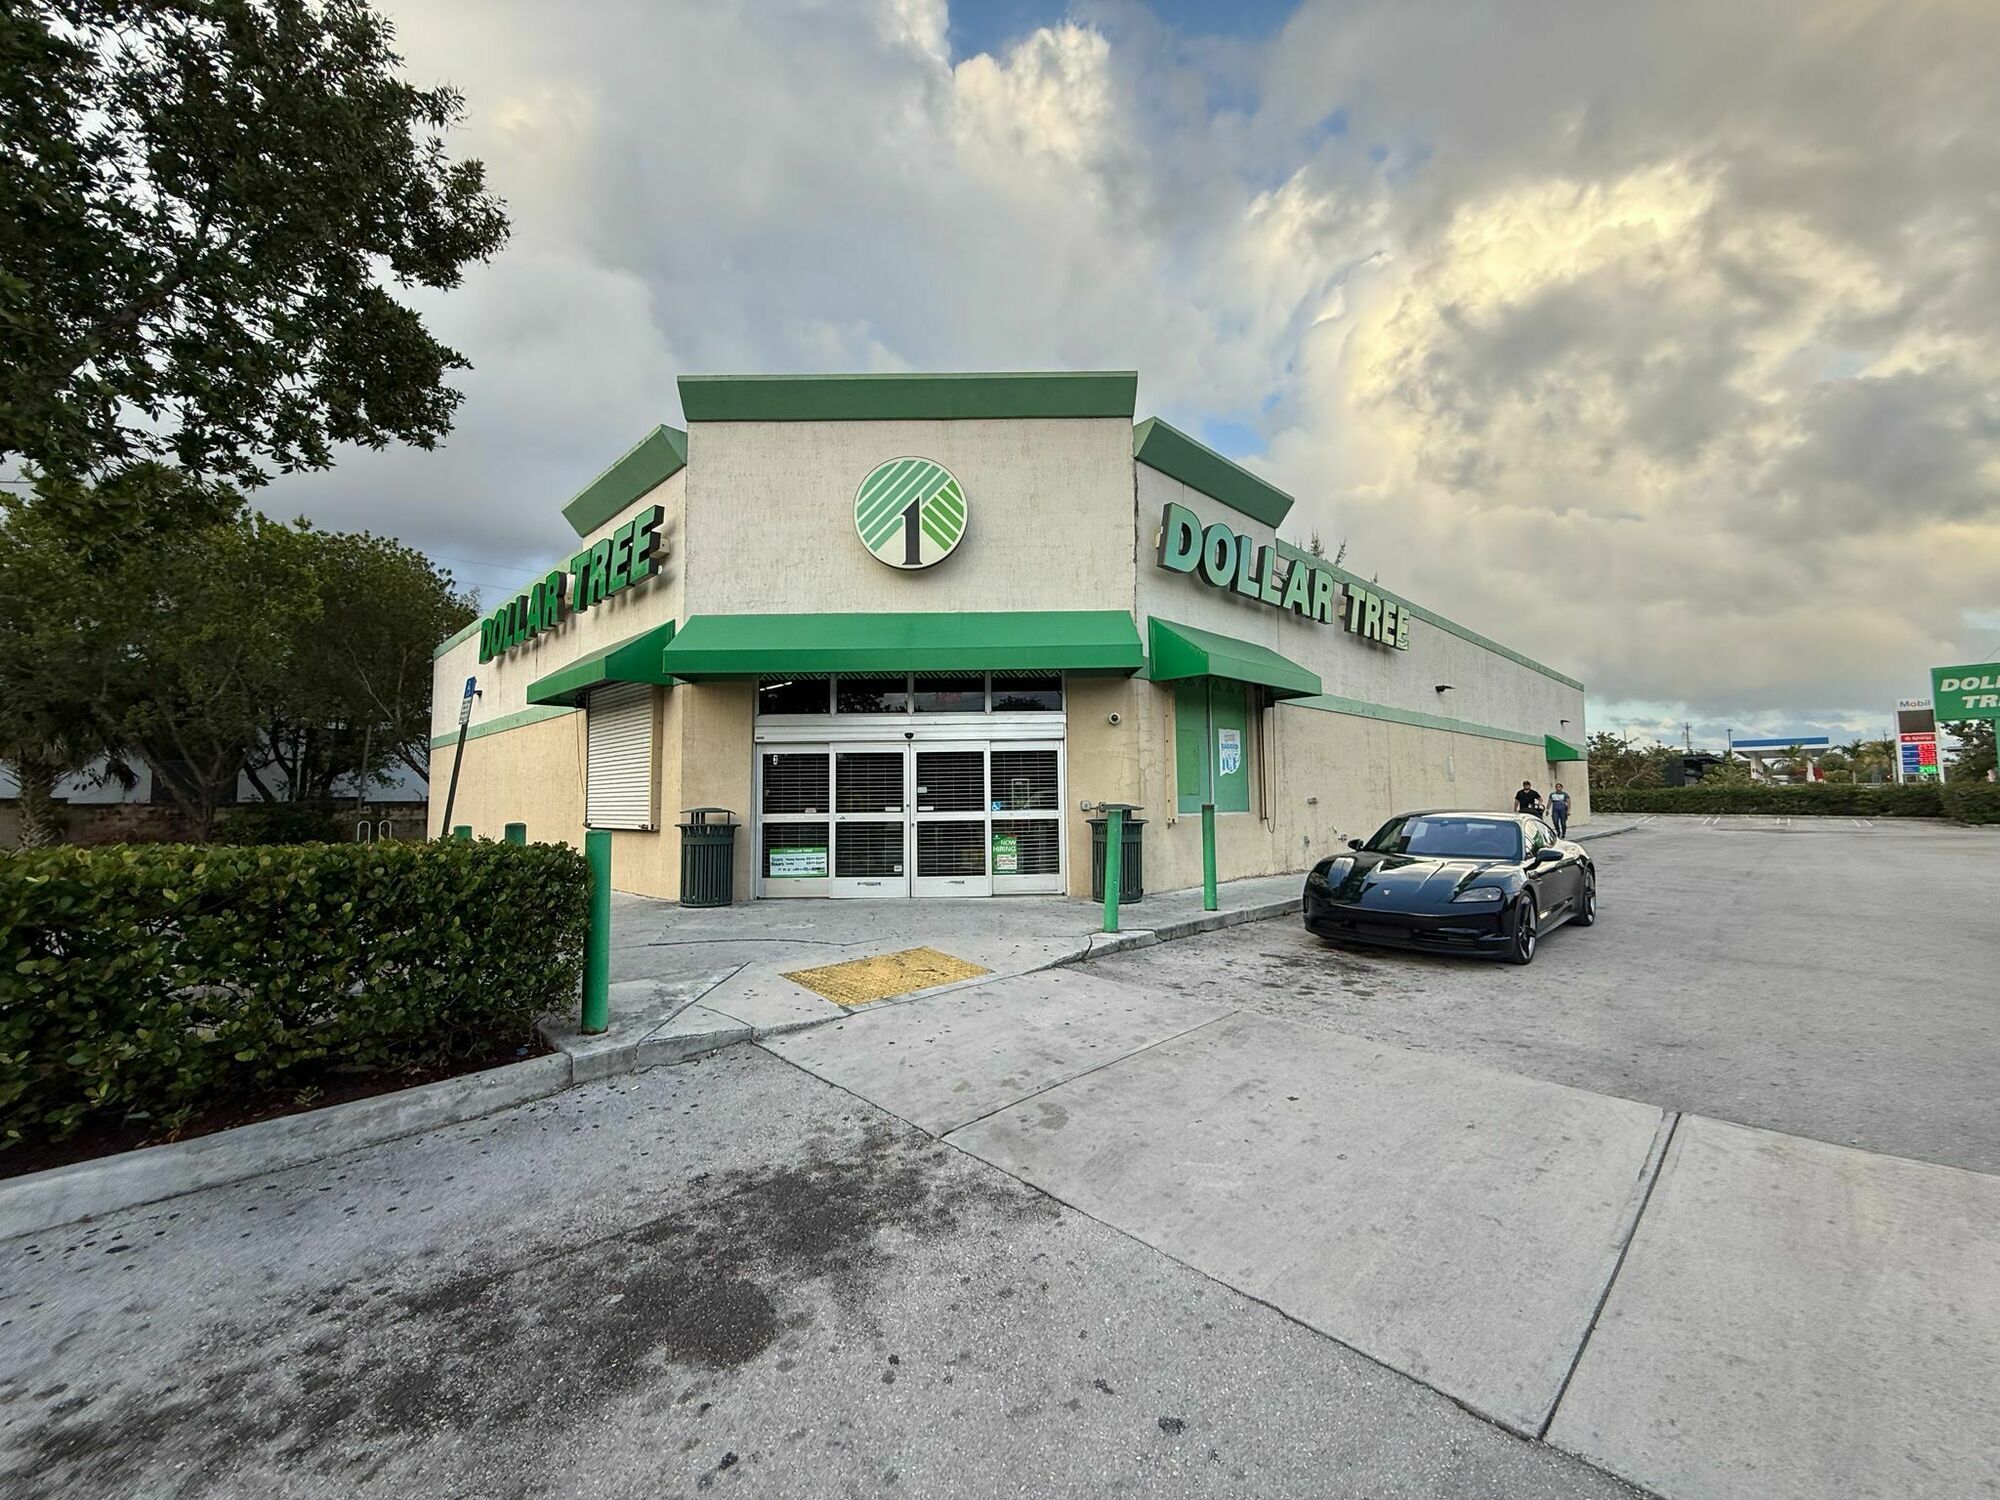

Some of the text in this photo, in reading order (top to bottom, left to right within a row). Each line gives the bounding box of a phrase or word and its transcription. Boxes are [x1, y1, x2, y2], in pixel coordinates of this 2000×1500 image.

[479, 505, 664, 664] DOLLAR TREE
[1157, 502, 1410, 651] DOLLAR TREE
[1900, 700, 1931, 708] Mobil
